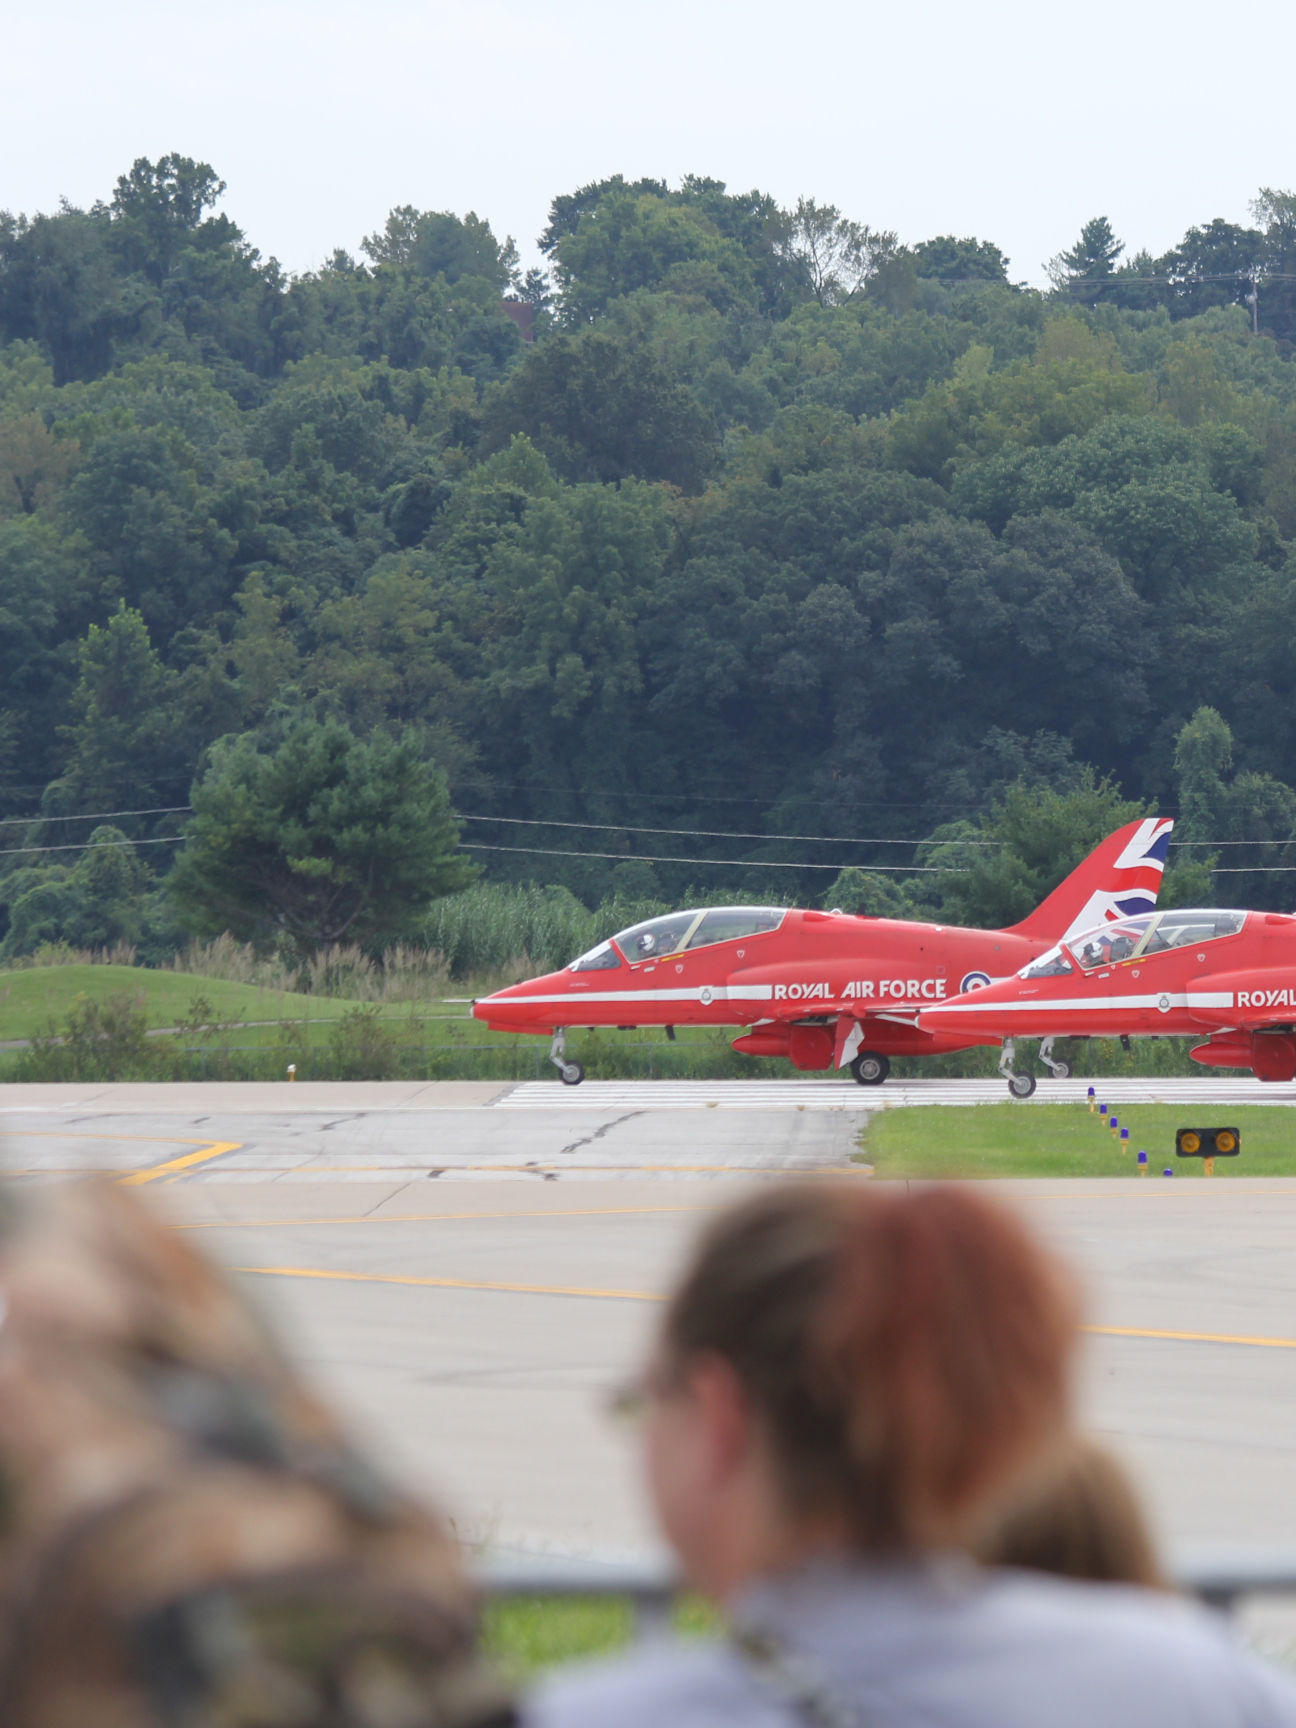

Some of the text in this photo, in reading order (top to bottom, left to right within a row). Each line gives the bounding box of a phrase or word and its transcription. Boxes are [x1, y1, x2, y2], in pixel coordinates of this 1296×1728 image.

[774, 979, 947, 1000] ROYAL AIR FORCE
